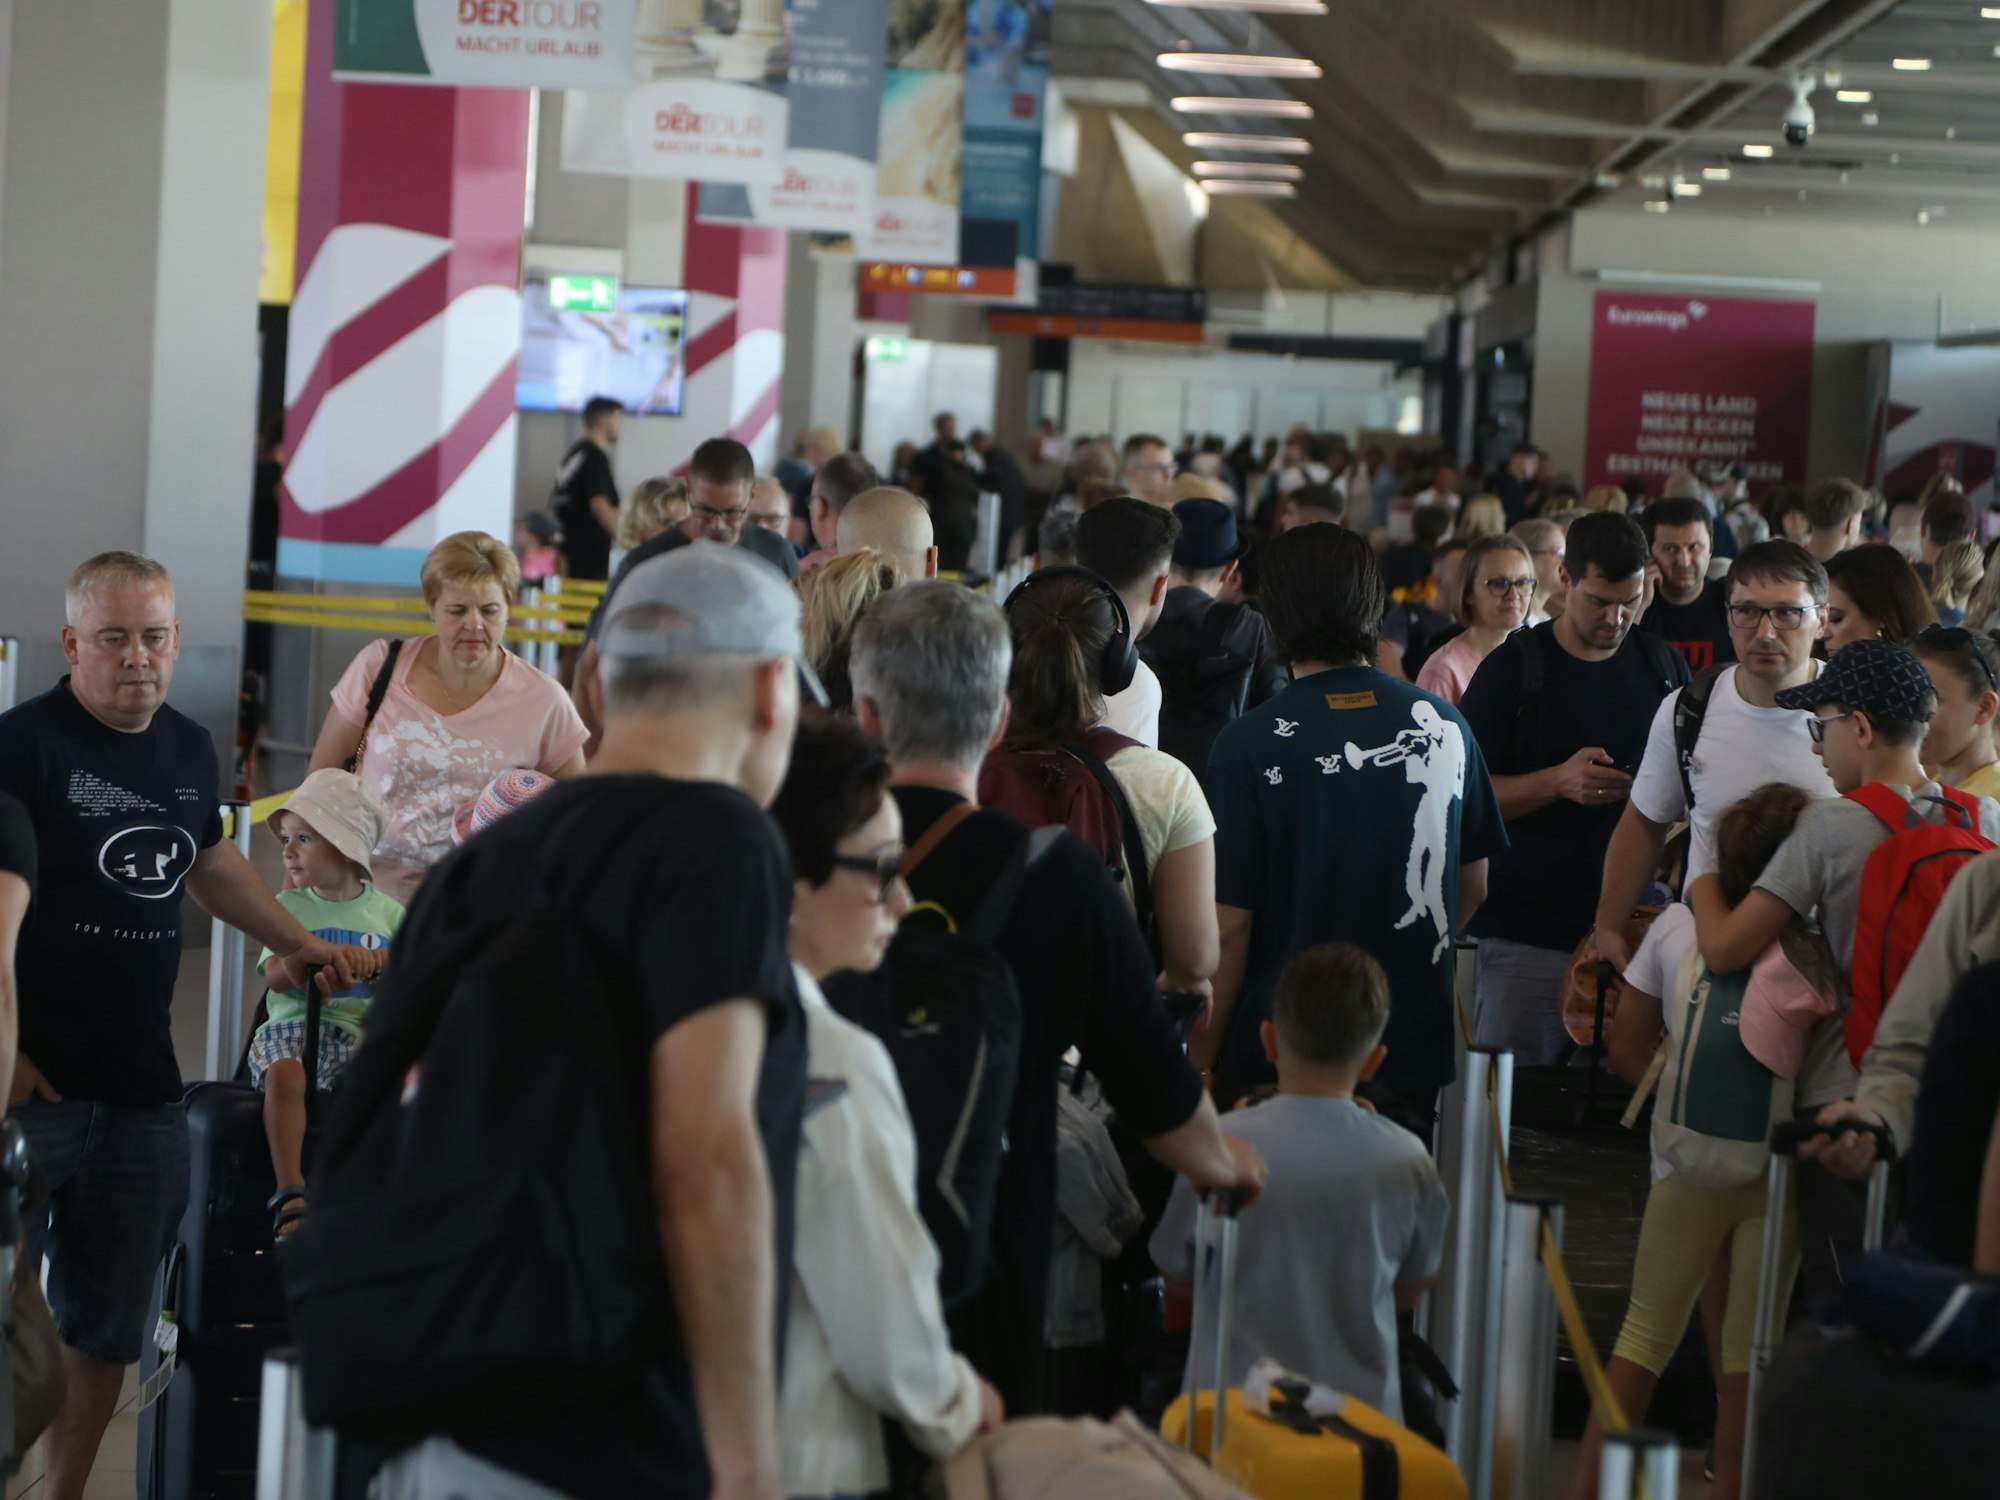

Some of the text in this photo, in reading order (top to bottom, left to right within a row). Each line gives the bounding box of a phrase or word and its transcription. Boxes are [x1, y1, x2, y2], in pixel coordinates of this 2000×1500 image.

[458, 0, 603, 30] DERTOUR
[456, 34, 603, 57] MACHT URLAUB
[1608, 305, 1688, 332] Eurowings
[1642, 391, 1757, 415] NEUES LAND
[1641, 413, 1755, 436] NEUE ECKEN
[74, 923, 101, 934] TOM
[113, 929, 161, 940] TAILOR
